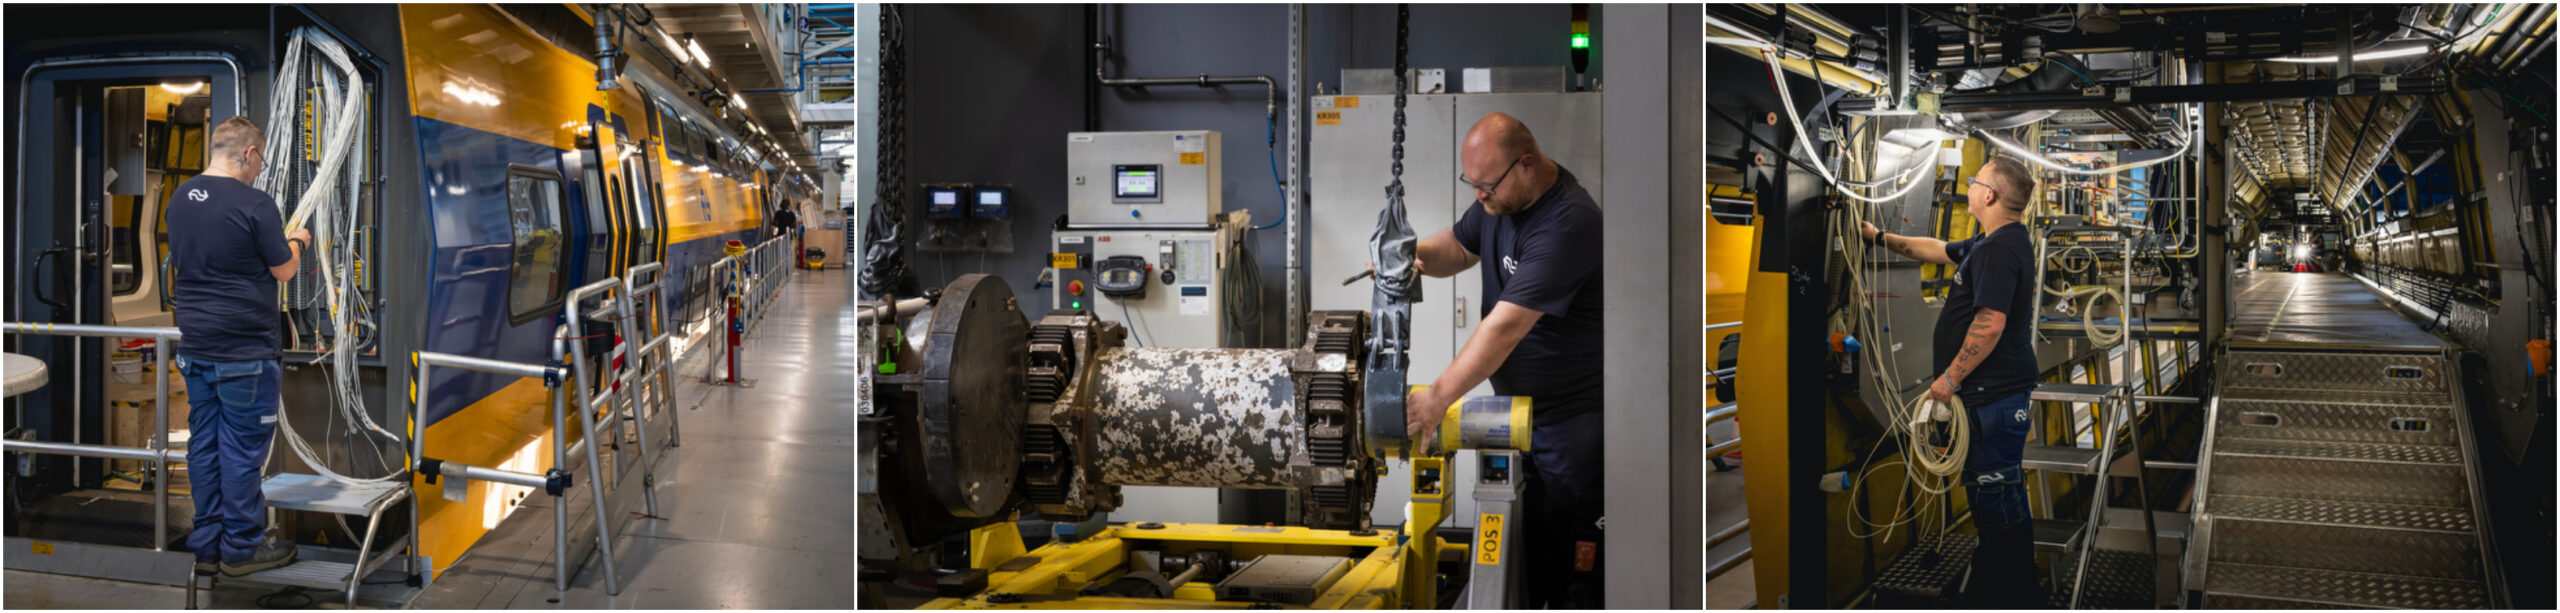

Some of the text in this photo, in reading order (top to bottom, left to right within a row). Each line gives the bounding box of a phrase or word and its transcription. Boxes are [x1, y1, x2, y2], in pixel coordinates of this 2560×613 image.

[860, 376, 870, 413] 030406
[1482, 515, 1500, 562] POS 3
